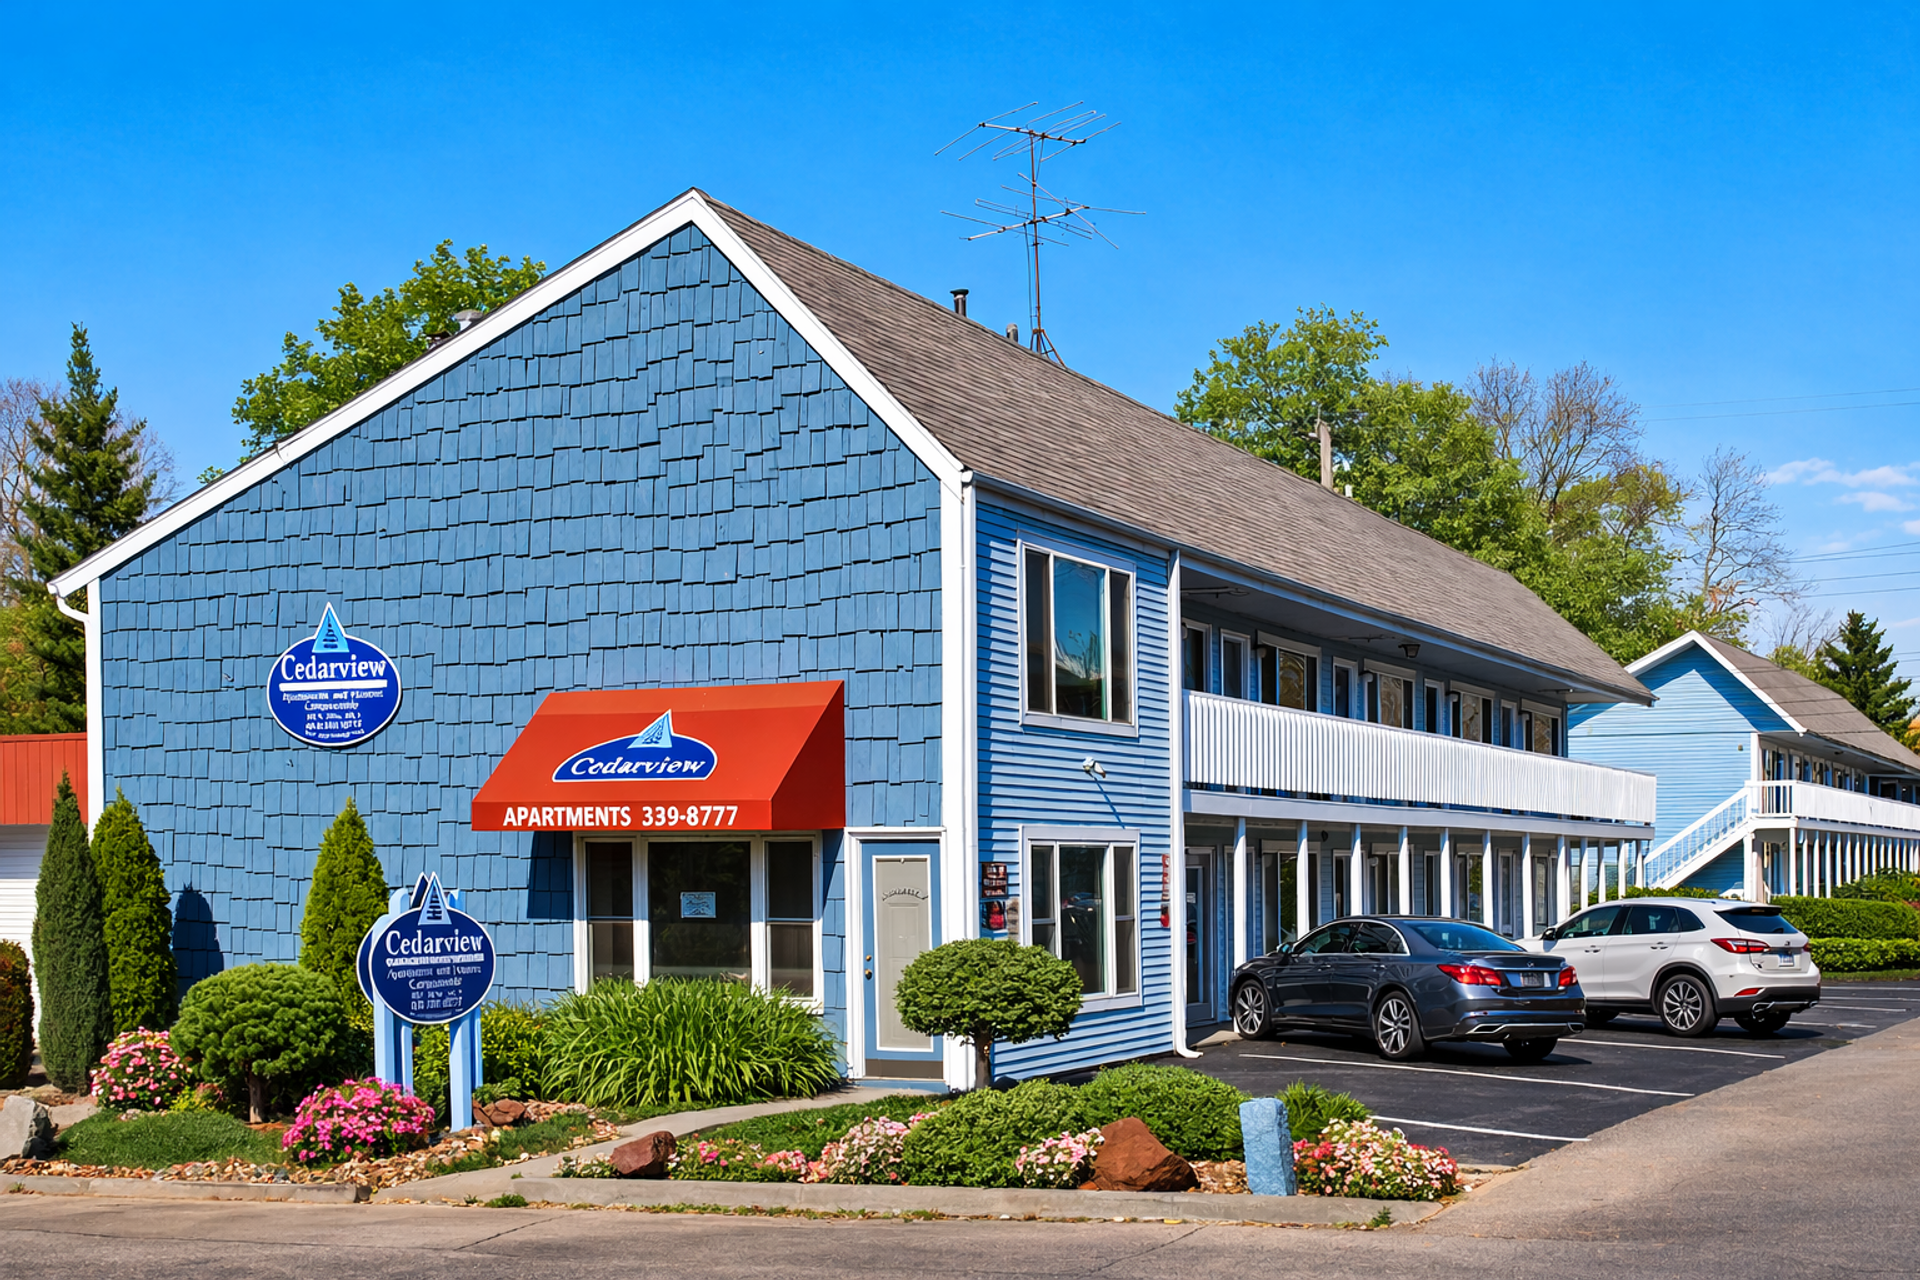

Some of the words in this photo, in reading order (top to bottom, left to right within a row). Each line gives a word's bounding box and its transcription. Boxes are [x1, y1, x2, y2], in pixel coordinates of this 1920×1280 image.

[281, 654, 387, 680] Cedarview
[503, 806, 632, 827] APARTMENTS
[642, 805, 738, 827] 339-8777
[385, 929, 483, 955] Cedarview
